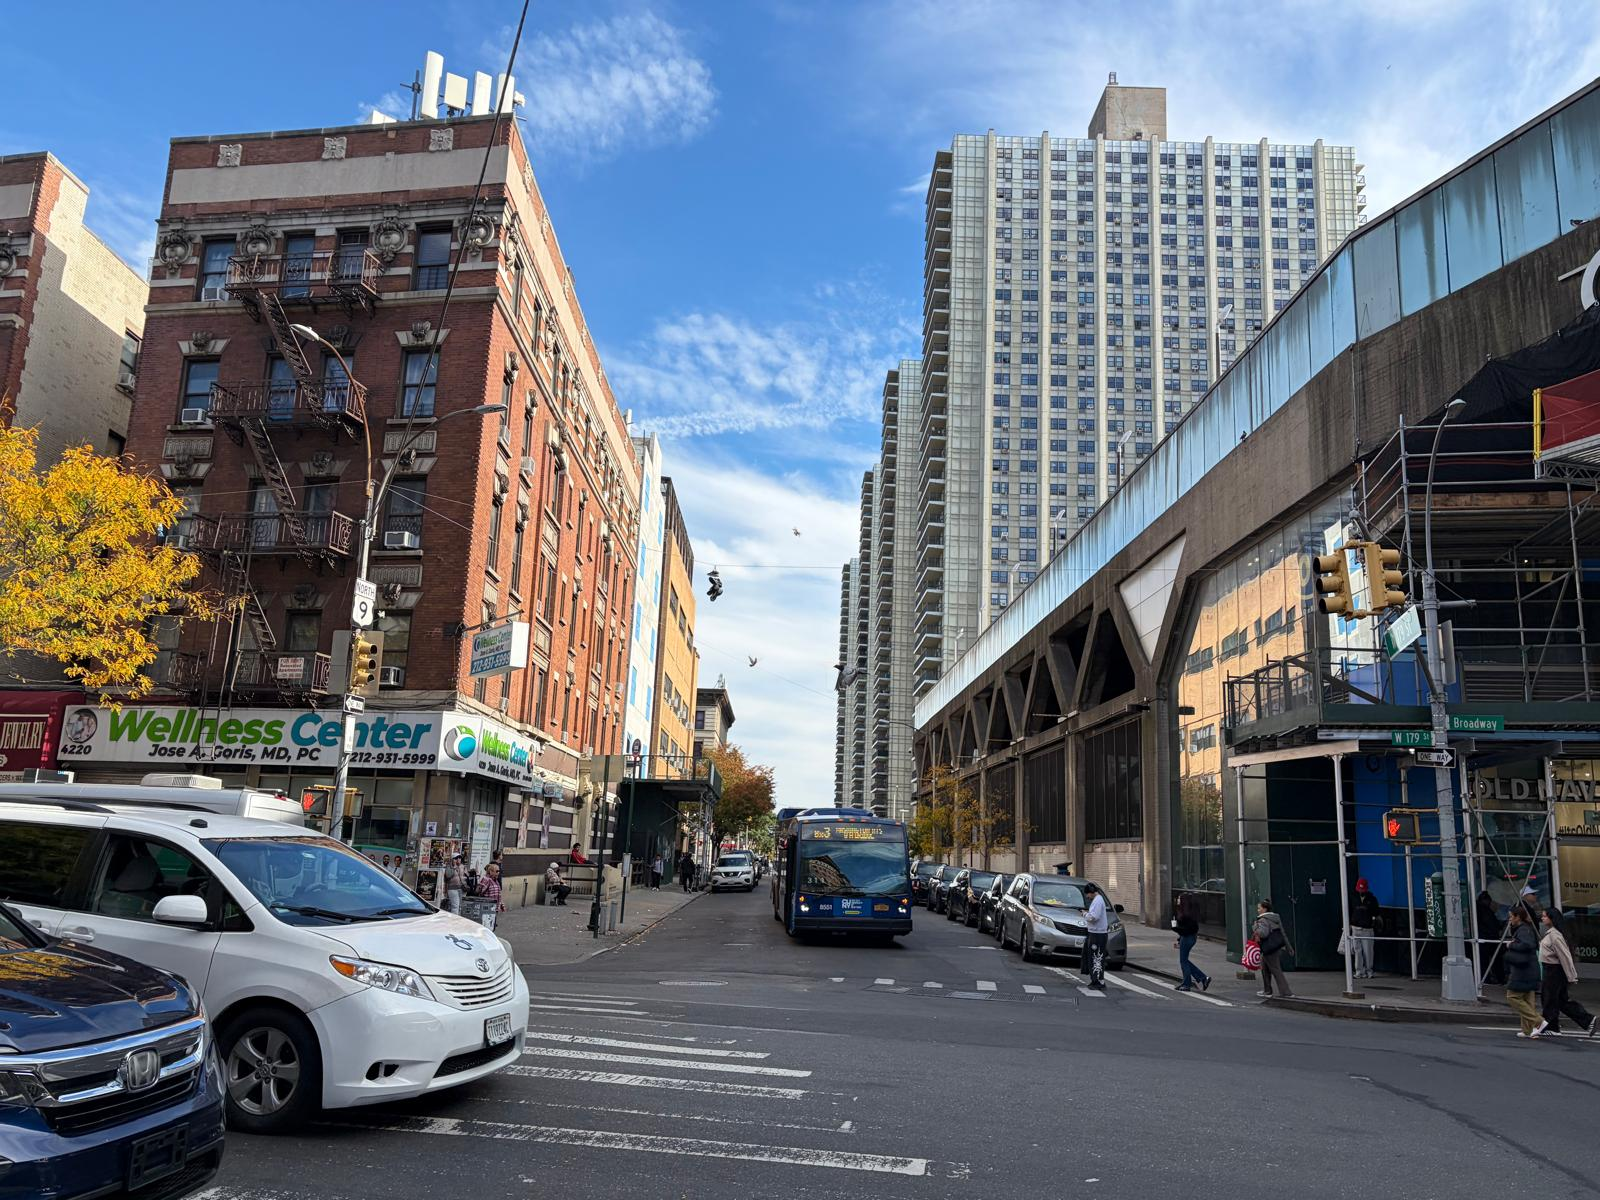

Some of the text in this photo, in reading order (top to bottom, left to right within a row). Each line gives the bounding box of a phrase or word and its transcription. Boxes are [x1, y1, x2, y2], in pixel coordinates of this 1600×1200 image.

[356, 581, 375, 598] NORTH
[359, 601, 367, 619] 9
[109, 708, 432, 749] Wellness Center
[1453, 717, 1497, 730] Broadway
[0, 721, 46, 750] JEWELRY
[1395, 732, 1402, 743] W
[1406, 732, 1420, 743] 179
[61, 744, 92, 755] 4220
[148, 744, 322, 762] Jose A. Goris, MD, PC
[481, 728, 529, 768] Wellness Center
[351, 752, 435, 764] 212-931-5999
[1436, 753, 1449, 761] WAY
[1472, 777, 1529, 800] OLD
[1575, 946, 1598, 957] 4208
